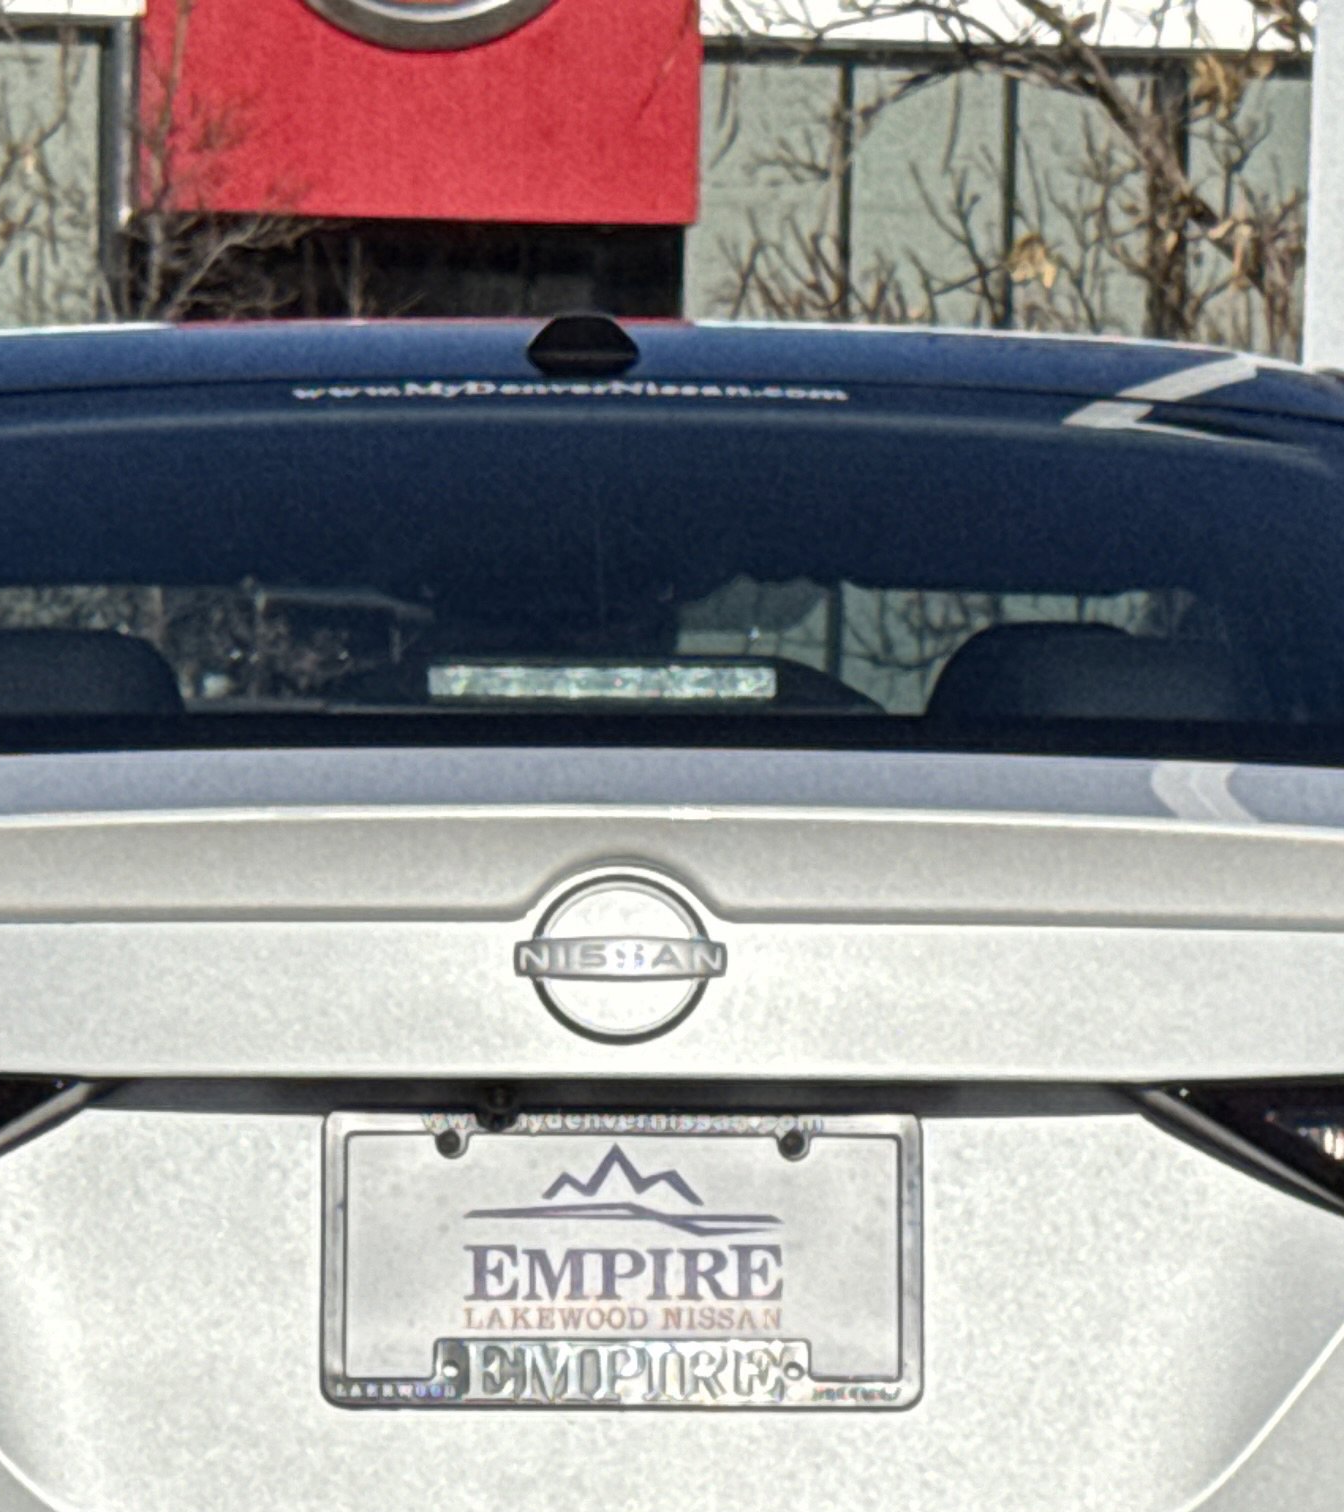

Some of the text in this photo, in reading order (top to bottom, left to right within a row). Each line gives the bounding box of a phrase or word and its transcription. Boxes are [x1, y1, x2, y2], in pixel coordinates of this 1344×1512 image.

[463, 1244, 784, 1301] EMPIRE
[463, 1307, 783, 1331] LAKEWOOD NISSAN
[462, 1339, 785, 1402] EMPIRE
